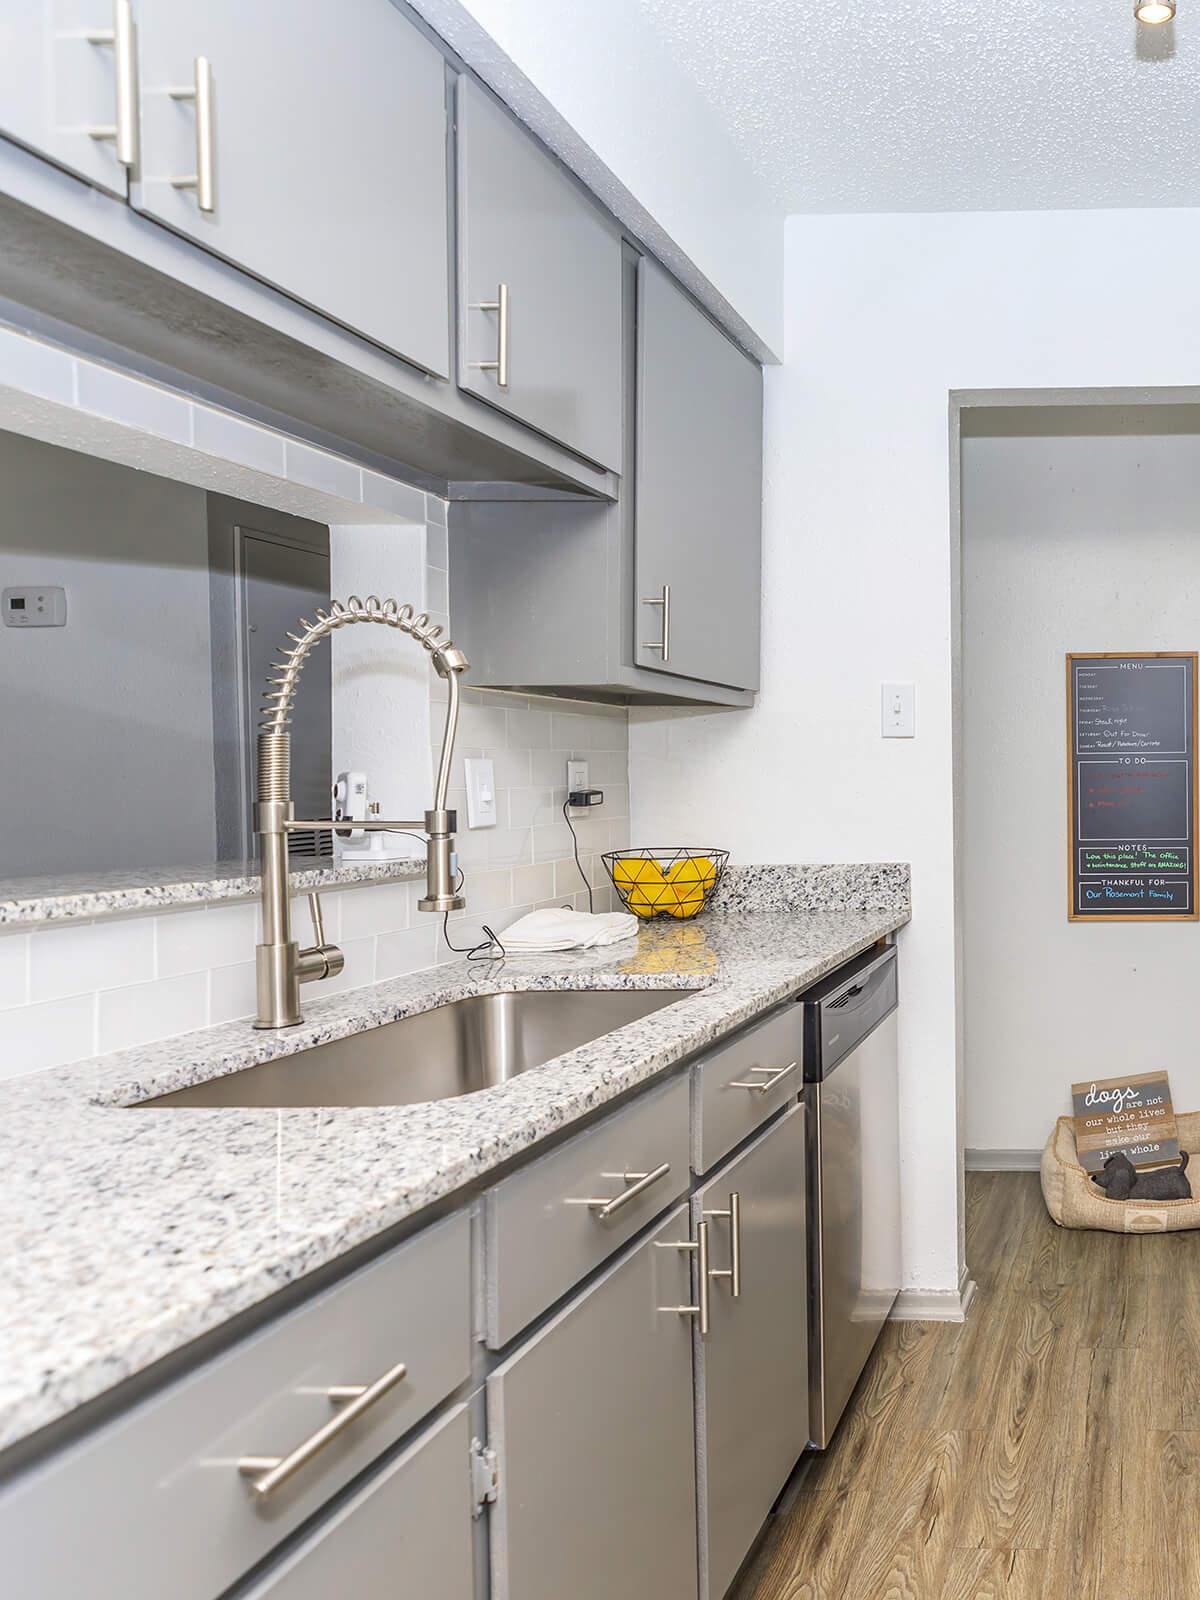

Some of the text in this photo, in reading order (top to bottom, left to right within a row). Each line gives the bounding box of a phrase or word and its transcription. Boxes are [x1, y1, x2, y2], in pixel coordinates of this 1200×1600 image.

[1103, 729, 1118, 738] Out
[1118, 844, 1147, 852] NOTES
[1142, 851, 1156, 859] The
[1101, 879, 1166, 887] THANKFUL FOR
[1086, 886, 1173, 901] Our Rosemont Family
[1085, 1083, 1140, 1113] dogs
[1126, 1096, 1164, 1109] are not
[1086, 1107, 1166, 1127] our whole lives
[1106, 1121, 1149, 1134] but they
[1105, 1132, 1151, 1146] make our
[1131, 1144, 1160, 1155] whole
